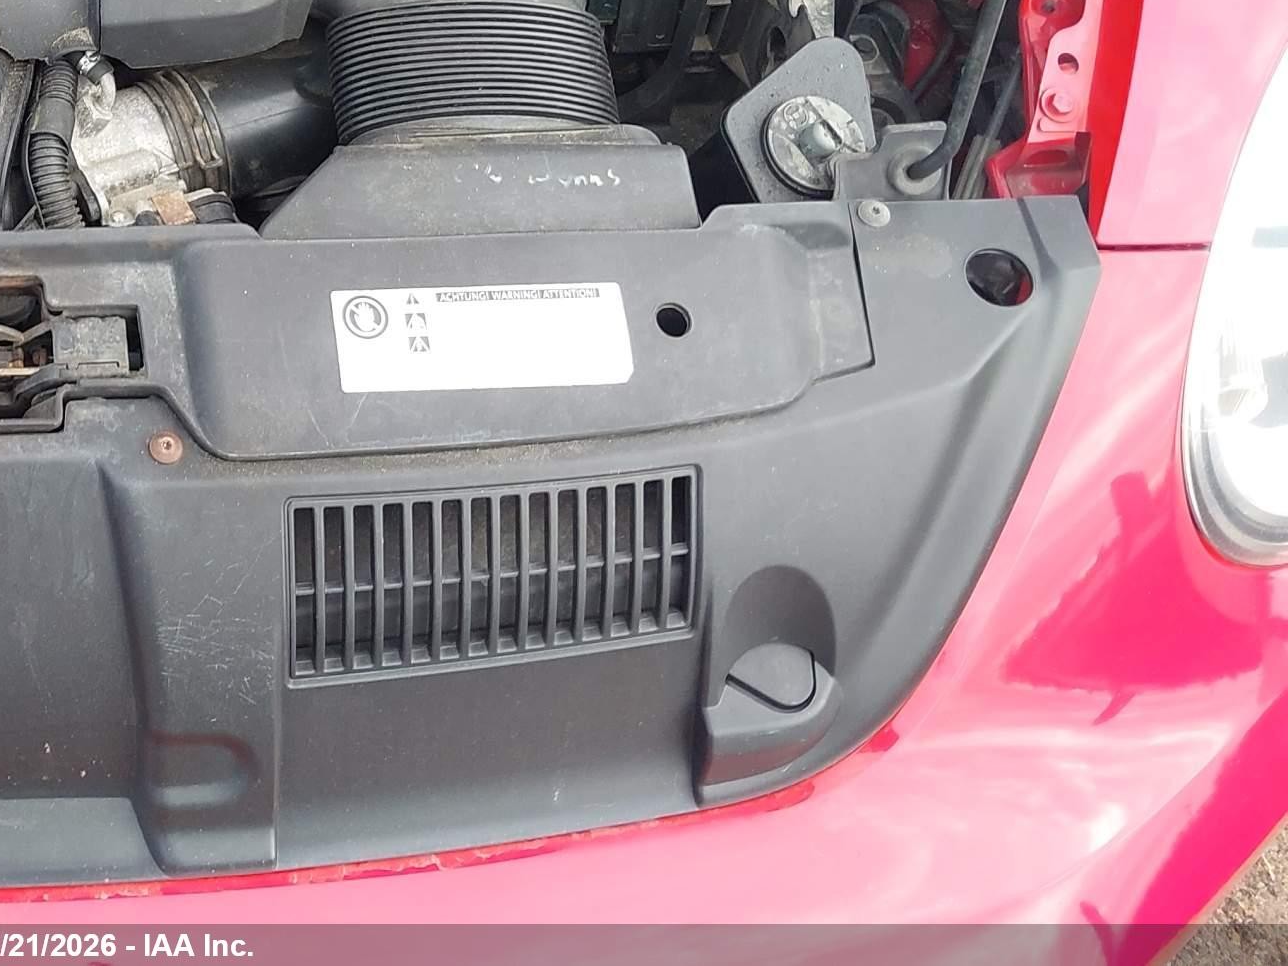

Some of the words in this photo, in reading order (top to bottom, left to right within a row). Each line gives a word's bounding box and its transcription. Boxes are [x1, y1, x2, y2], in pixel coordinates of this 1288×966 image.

[439, 291, 488, 303] ACHTUNG!
[491, 289, 540, 301] WARNING!
[543, 287, 597, 299] ATTENTION!
